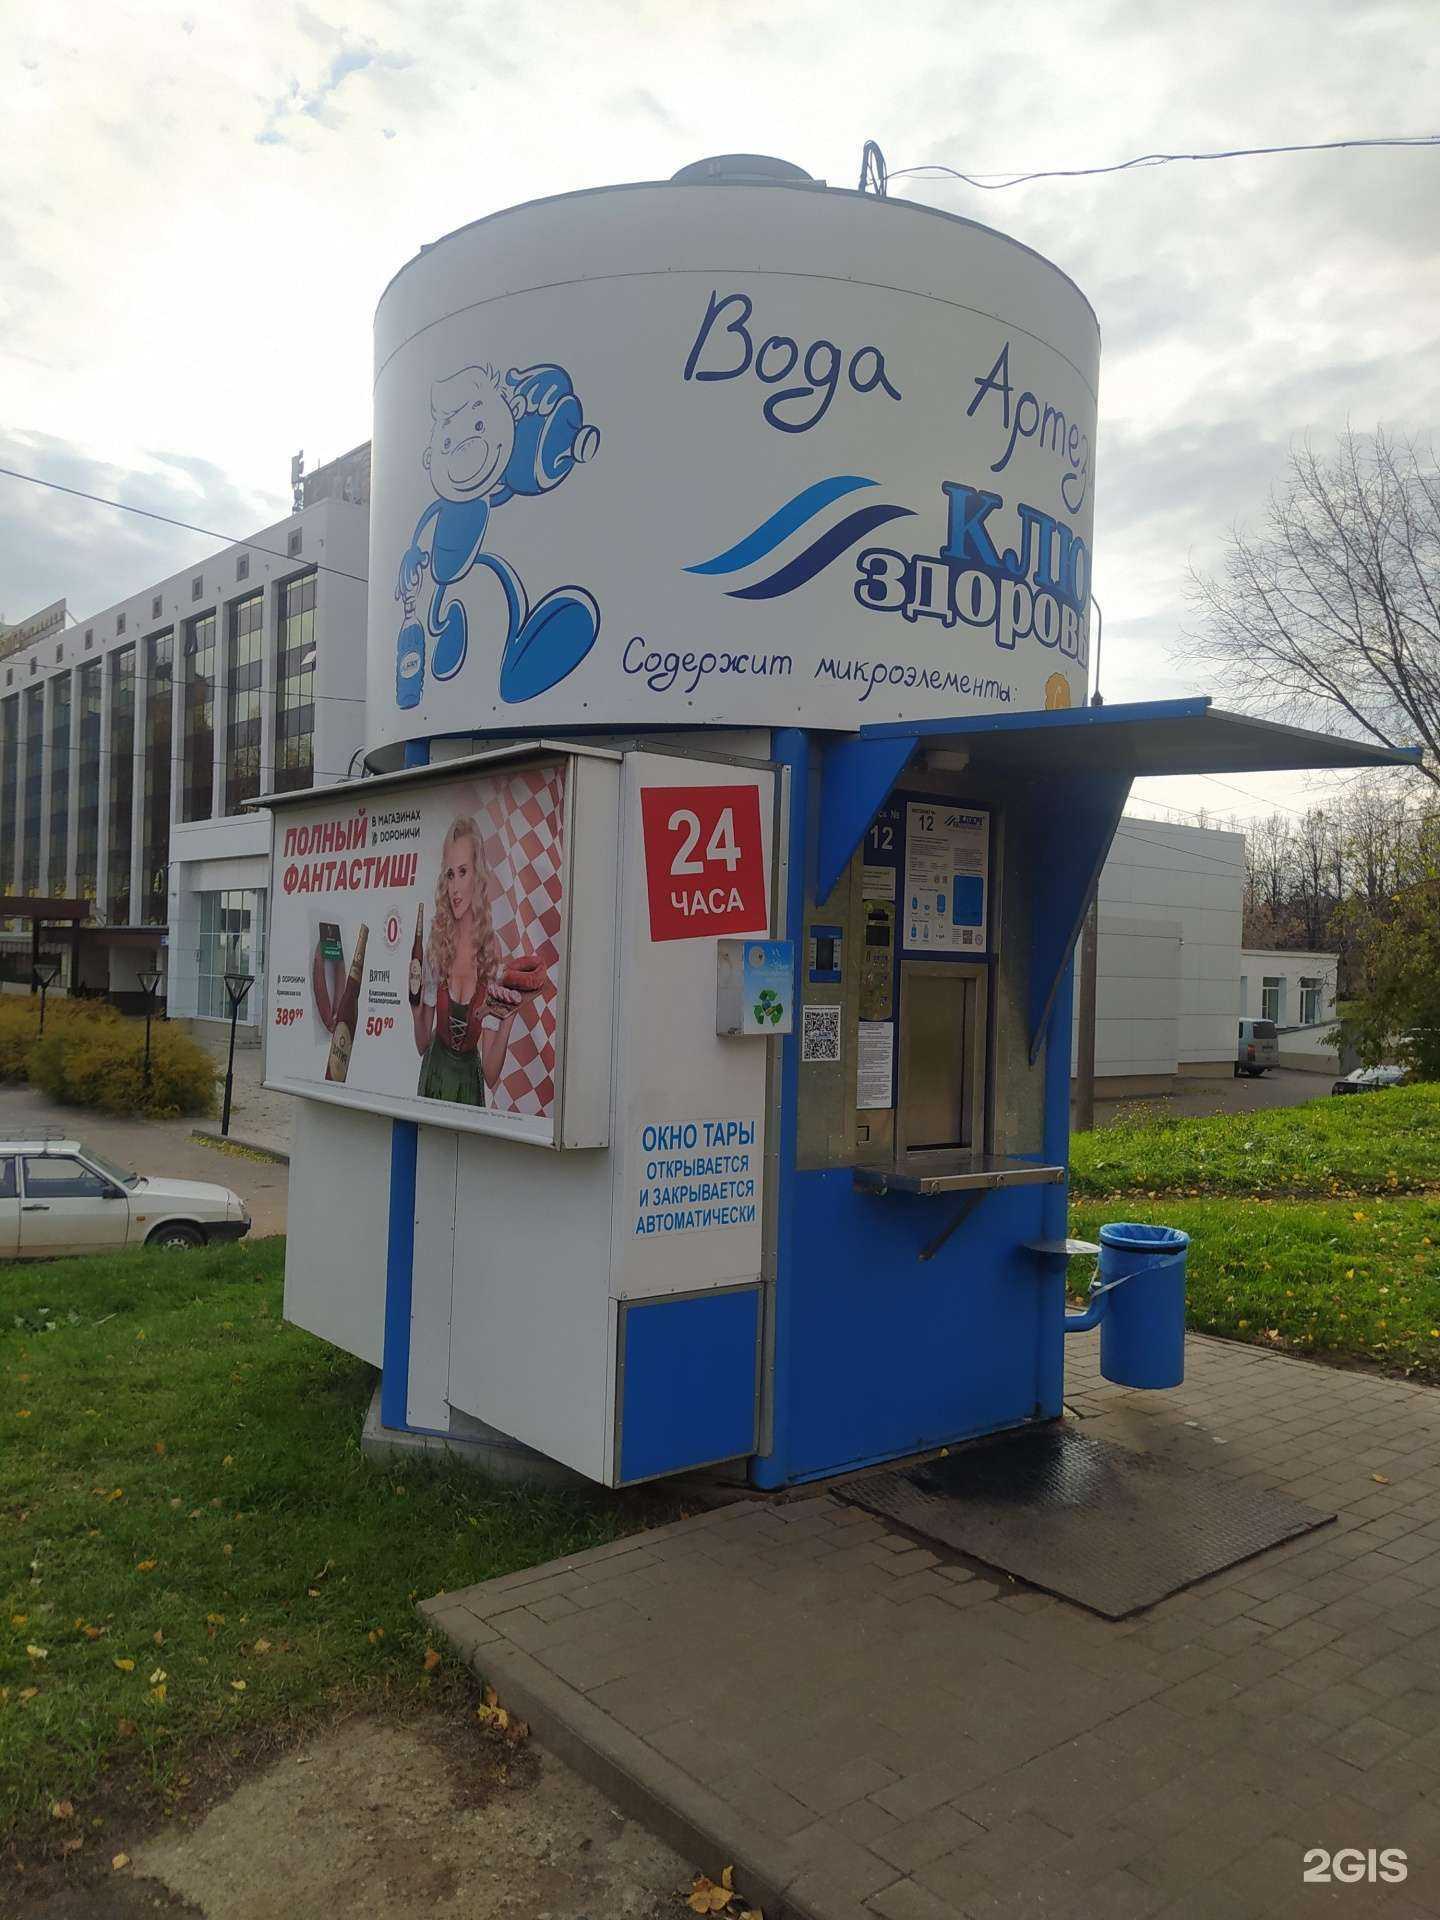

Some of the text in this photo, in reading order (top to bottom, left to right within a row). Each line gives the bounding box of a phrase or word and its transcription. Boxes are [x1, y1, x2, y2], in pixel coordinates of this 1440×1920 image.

[683, 289, 903, 434] Вода
[622, 637, 1019, 702] Содержит микроэлементы:
[378, 809, 421, 826] МАГАЗИНАХ
[919, 815, 934, 831] 12
[283, 808, 369, 857] ПОЛНЫЙ
[667, 807, 742, 876] 24
[870, 824, 893, 849] 12
[283, 853, 418, 895] ФАНТАСТИШ!
[671, 887, 745, 916] ЧАСА
[642, 1120, 755, 1151] ОКНО ТАРЫ
[646, 1155, 749, 1180] ОТКРЫВАЕТСЯ
[639, 1180, 755, 1207] И ЗАКРЫВАЕТСЯ
[635, 1205, 756, 1234] АВТОМАТИЧЕСКИ
